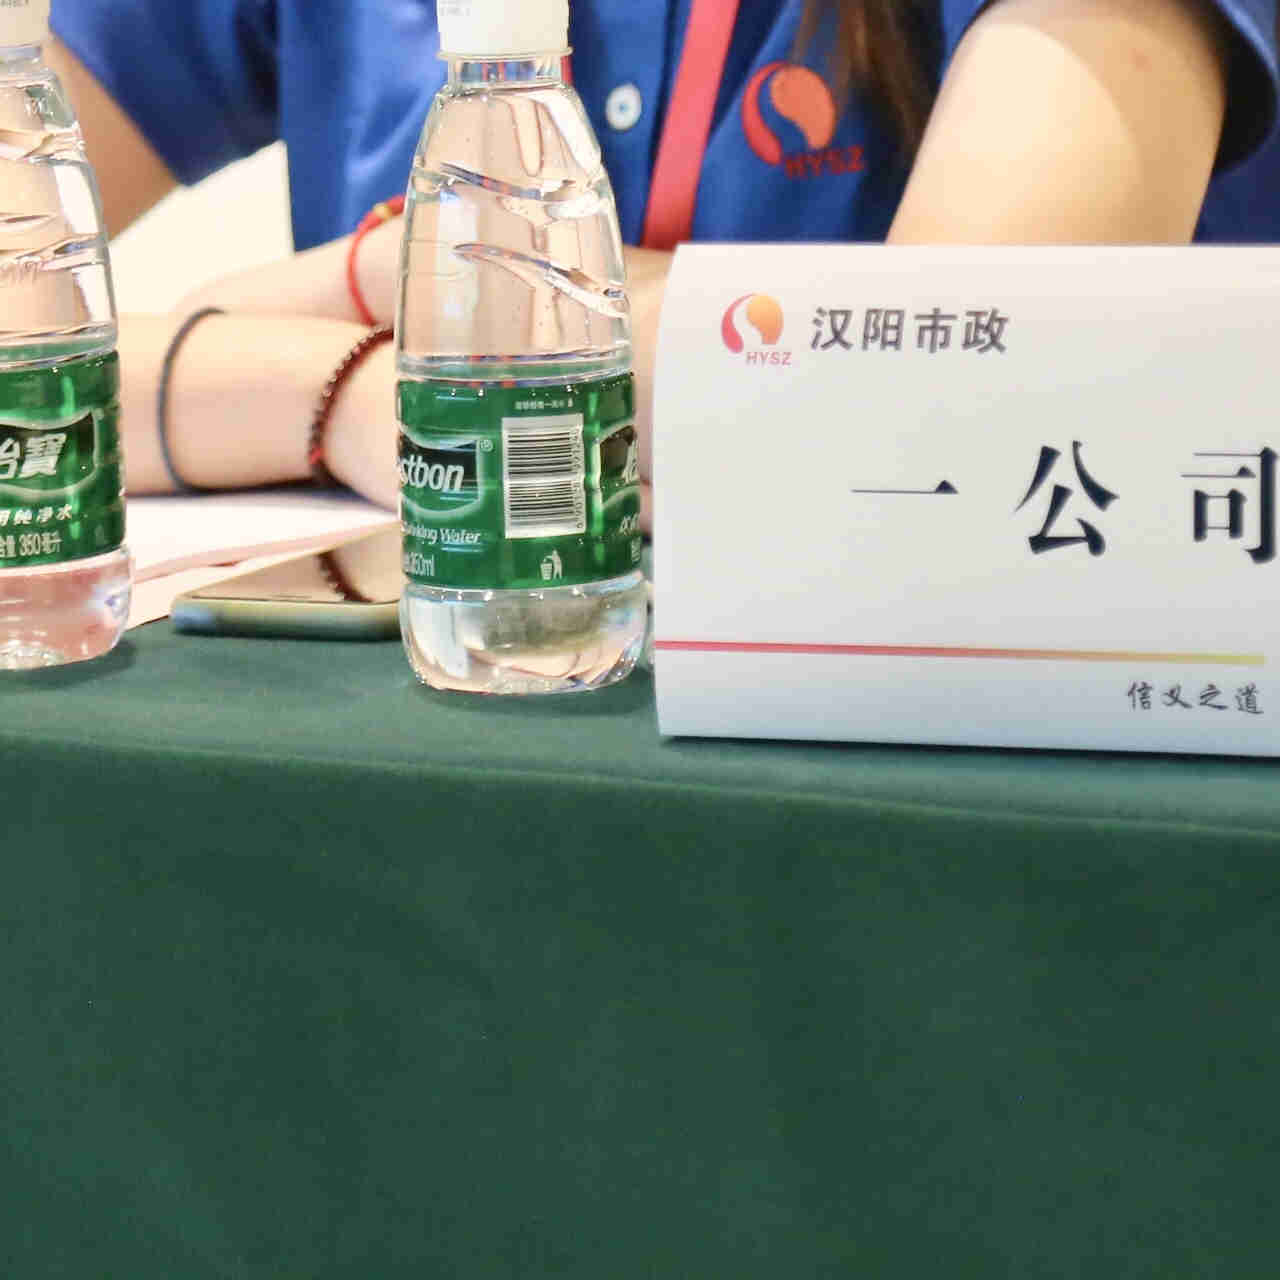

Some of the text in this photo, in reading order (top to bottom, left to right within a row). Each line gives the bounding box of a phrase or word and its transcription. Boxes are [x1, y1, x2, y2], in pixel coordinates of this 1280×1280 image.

[810, 305, 1009, 354] 汉阳市政
[745, 350, 792, 366] HYSZ
[850, 439, 1280, 565] 一公司
